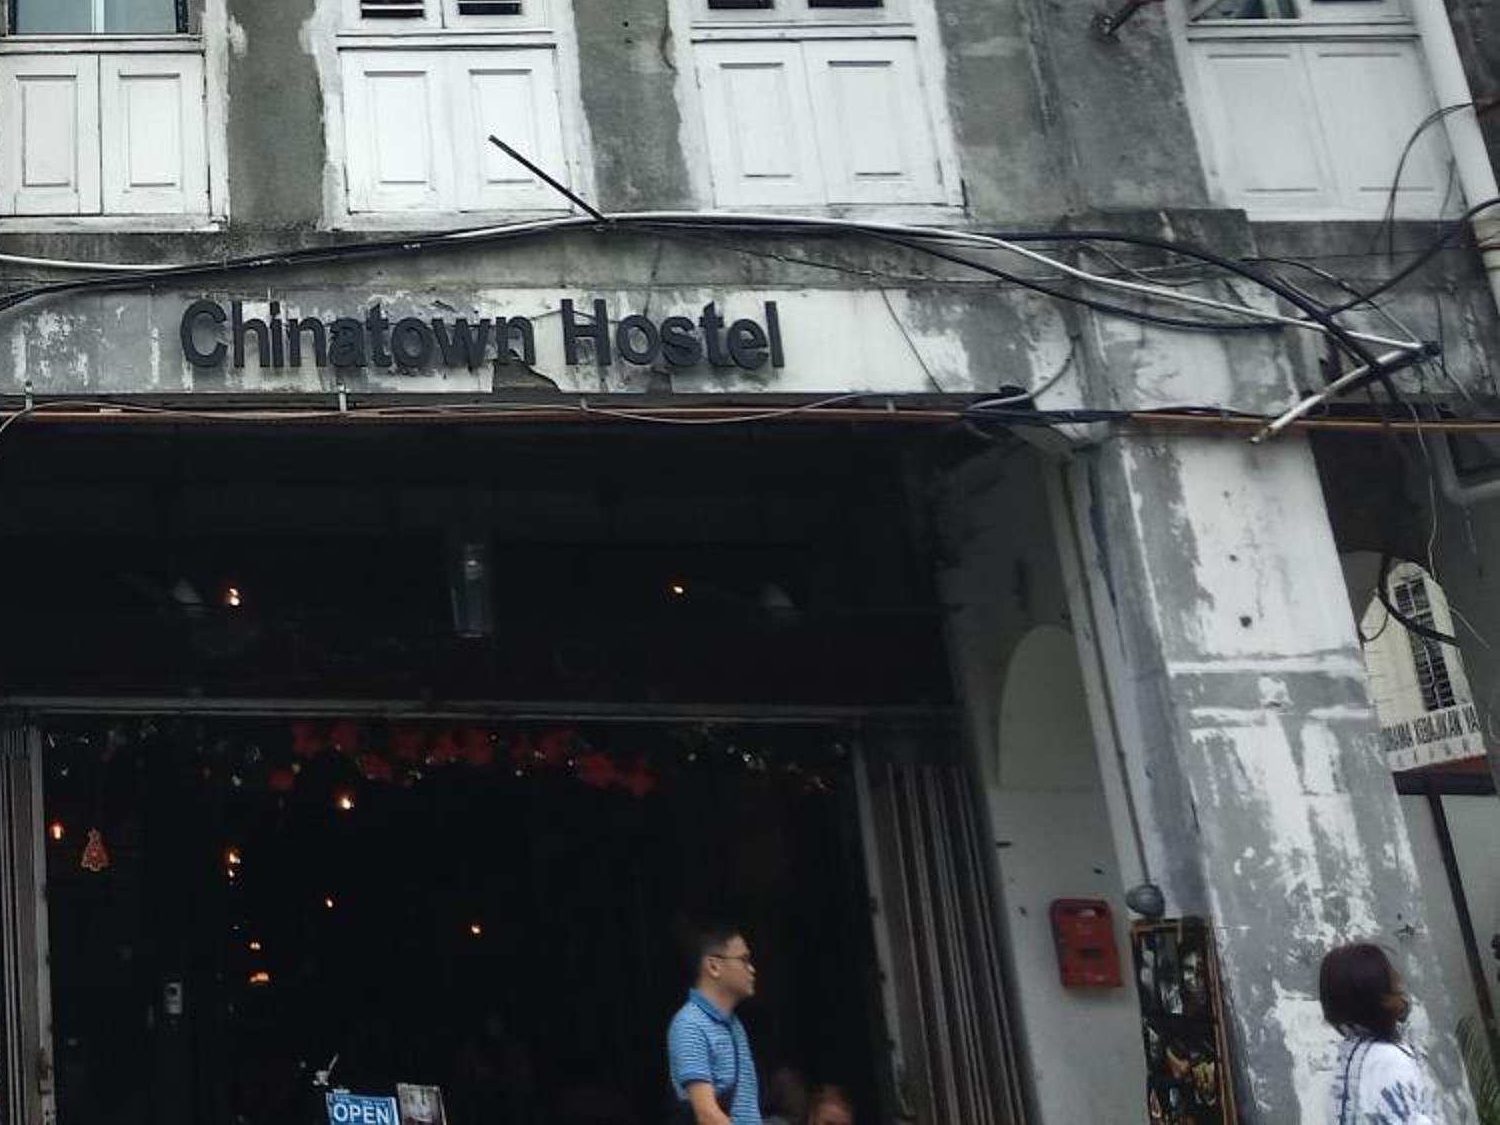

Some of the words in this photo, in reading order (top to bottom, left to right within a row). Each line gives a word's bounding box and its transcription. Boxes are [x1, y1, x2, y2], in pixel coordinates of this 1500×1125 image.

[180, 298, 537, 370] Chinatown
[561, 298, 785, 370] Hostel
[333, 1102, 390, 1124] OPEN
